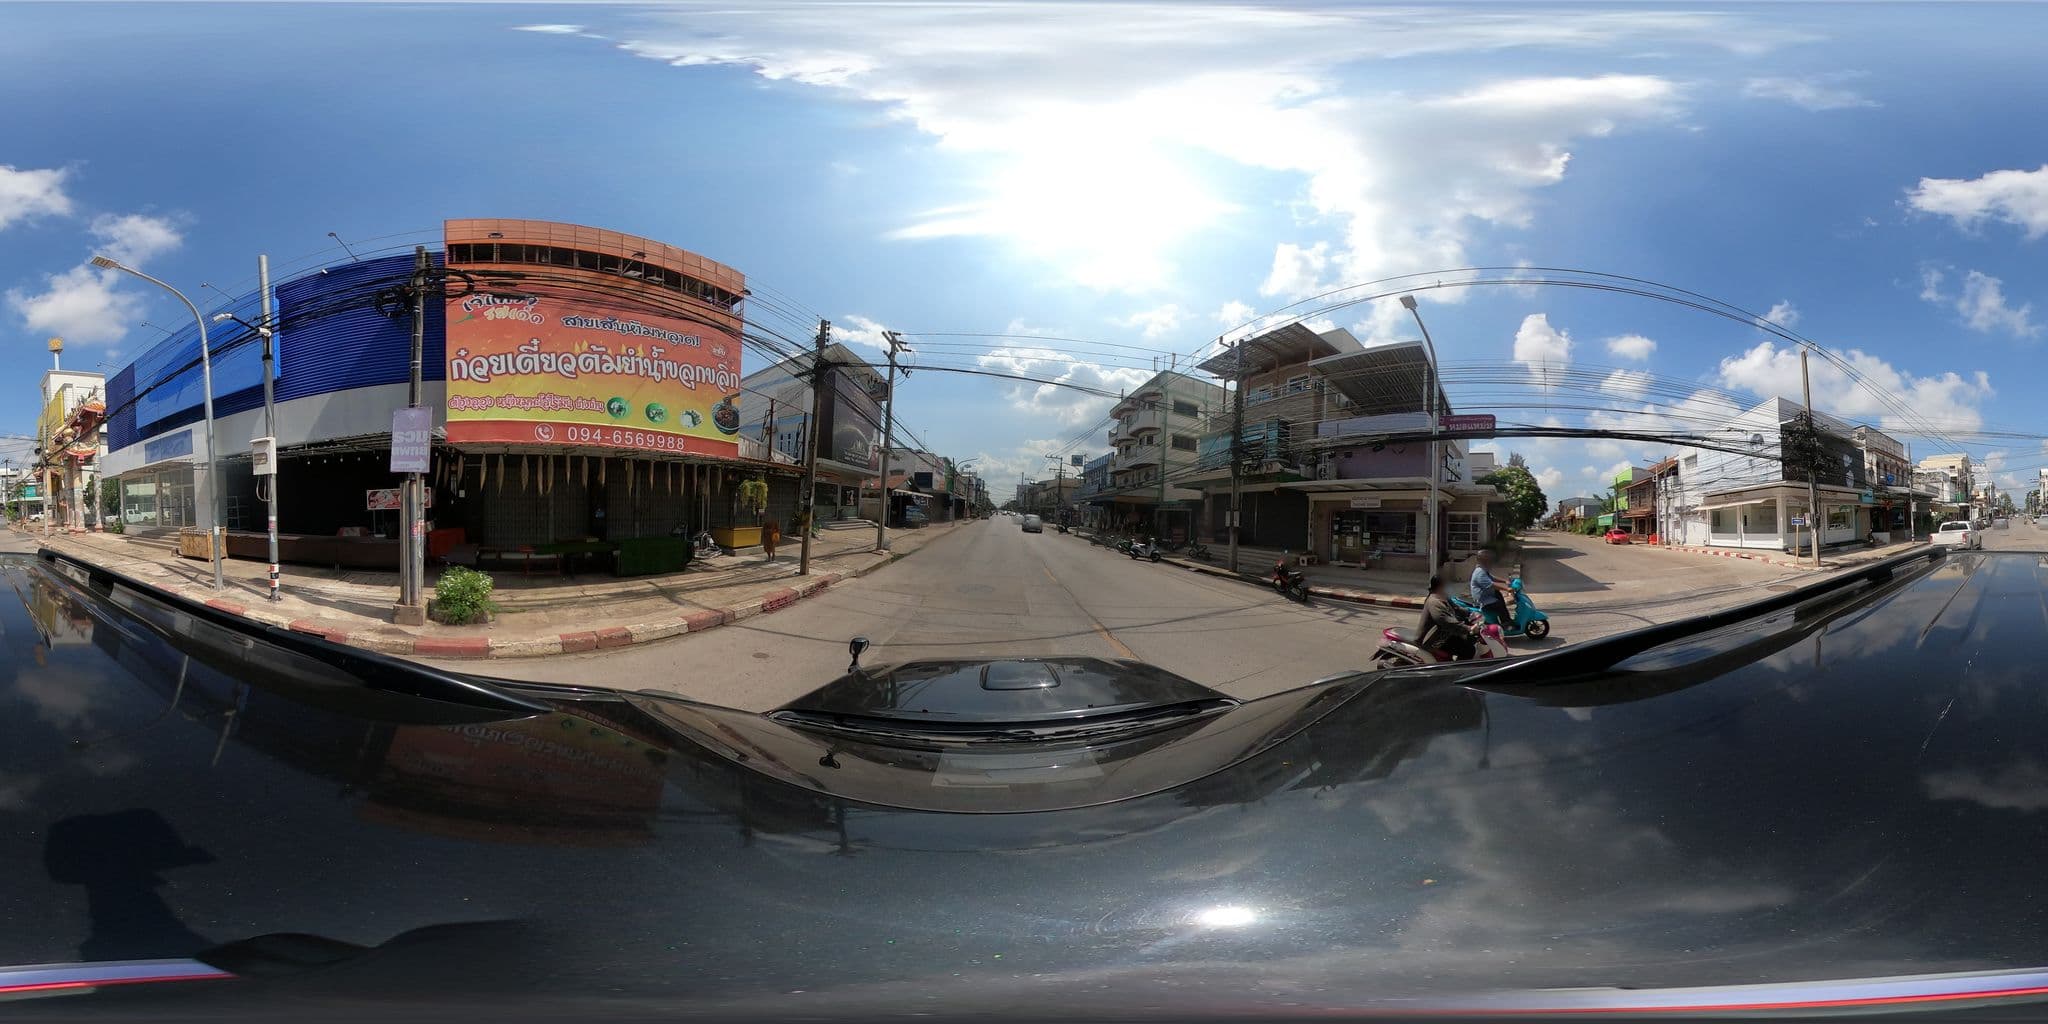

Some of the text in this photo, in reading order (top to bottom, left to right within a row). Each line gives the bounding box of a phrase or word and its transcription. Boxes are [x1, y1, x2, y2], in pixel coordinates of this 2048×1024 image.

[561, 315, 701, 348] สายเส้นห้ามพลาด!
[449, 339, 740, 392] ก๋วยเตี๋ยวต้มยำน้ำขลุกขลิก
[567, 426, 685, 451] 094-6569988
